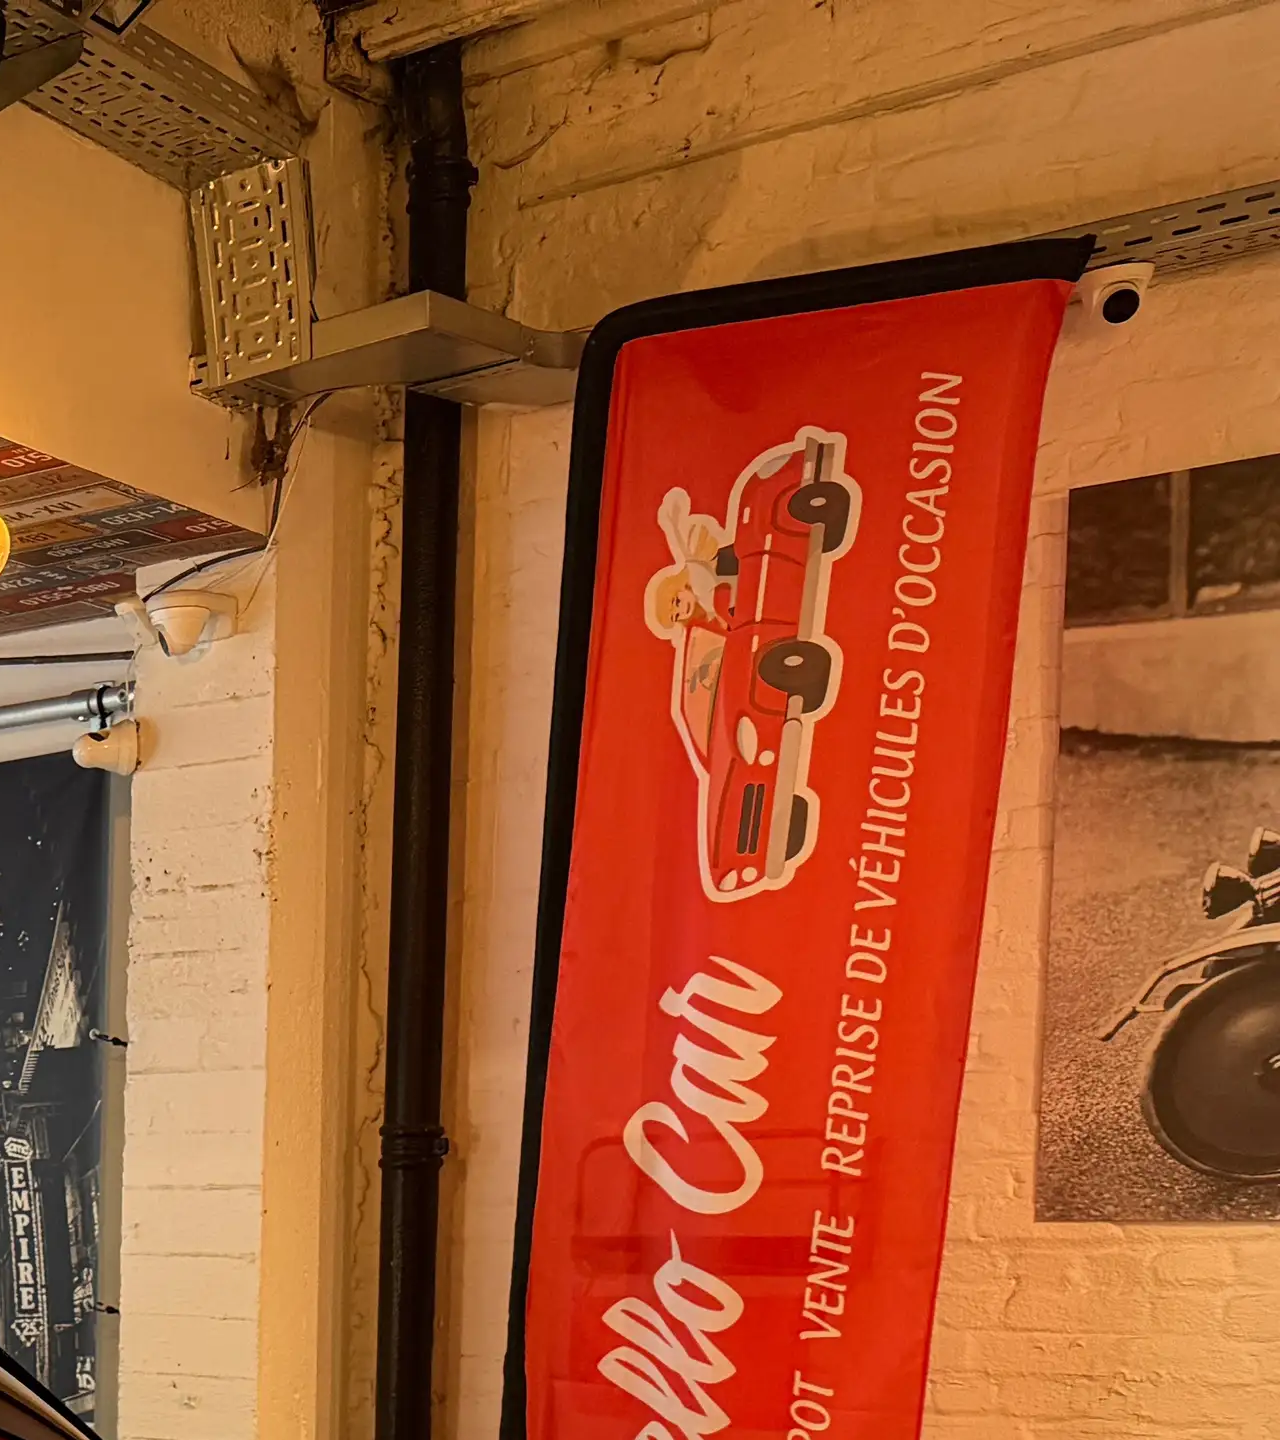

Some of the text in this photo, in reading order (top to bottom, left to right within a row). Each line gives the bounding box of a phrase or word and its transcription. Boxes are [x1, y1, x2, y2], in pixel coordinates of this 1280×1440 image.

[890, 371, 964, 657] D'OCCASION
[846, 669, 925, 912] VÉHICULES
[846, 924, 891, 985] DE
[623, 955, 783, 1215] Car
[823, 991, 884, 1177] REPRISE
[9, 1167, 37, 1311] EMPIRE
[800, 1209, 855, 1343] VENTE
